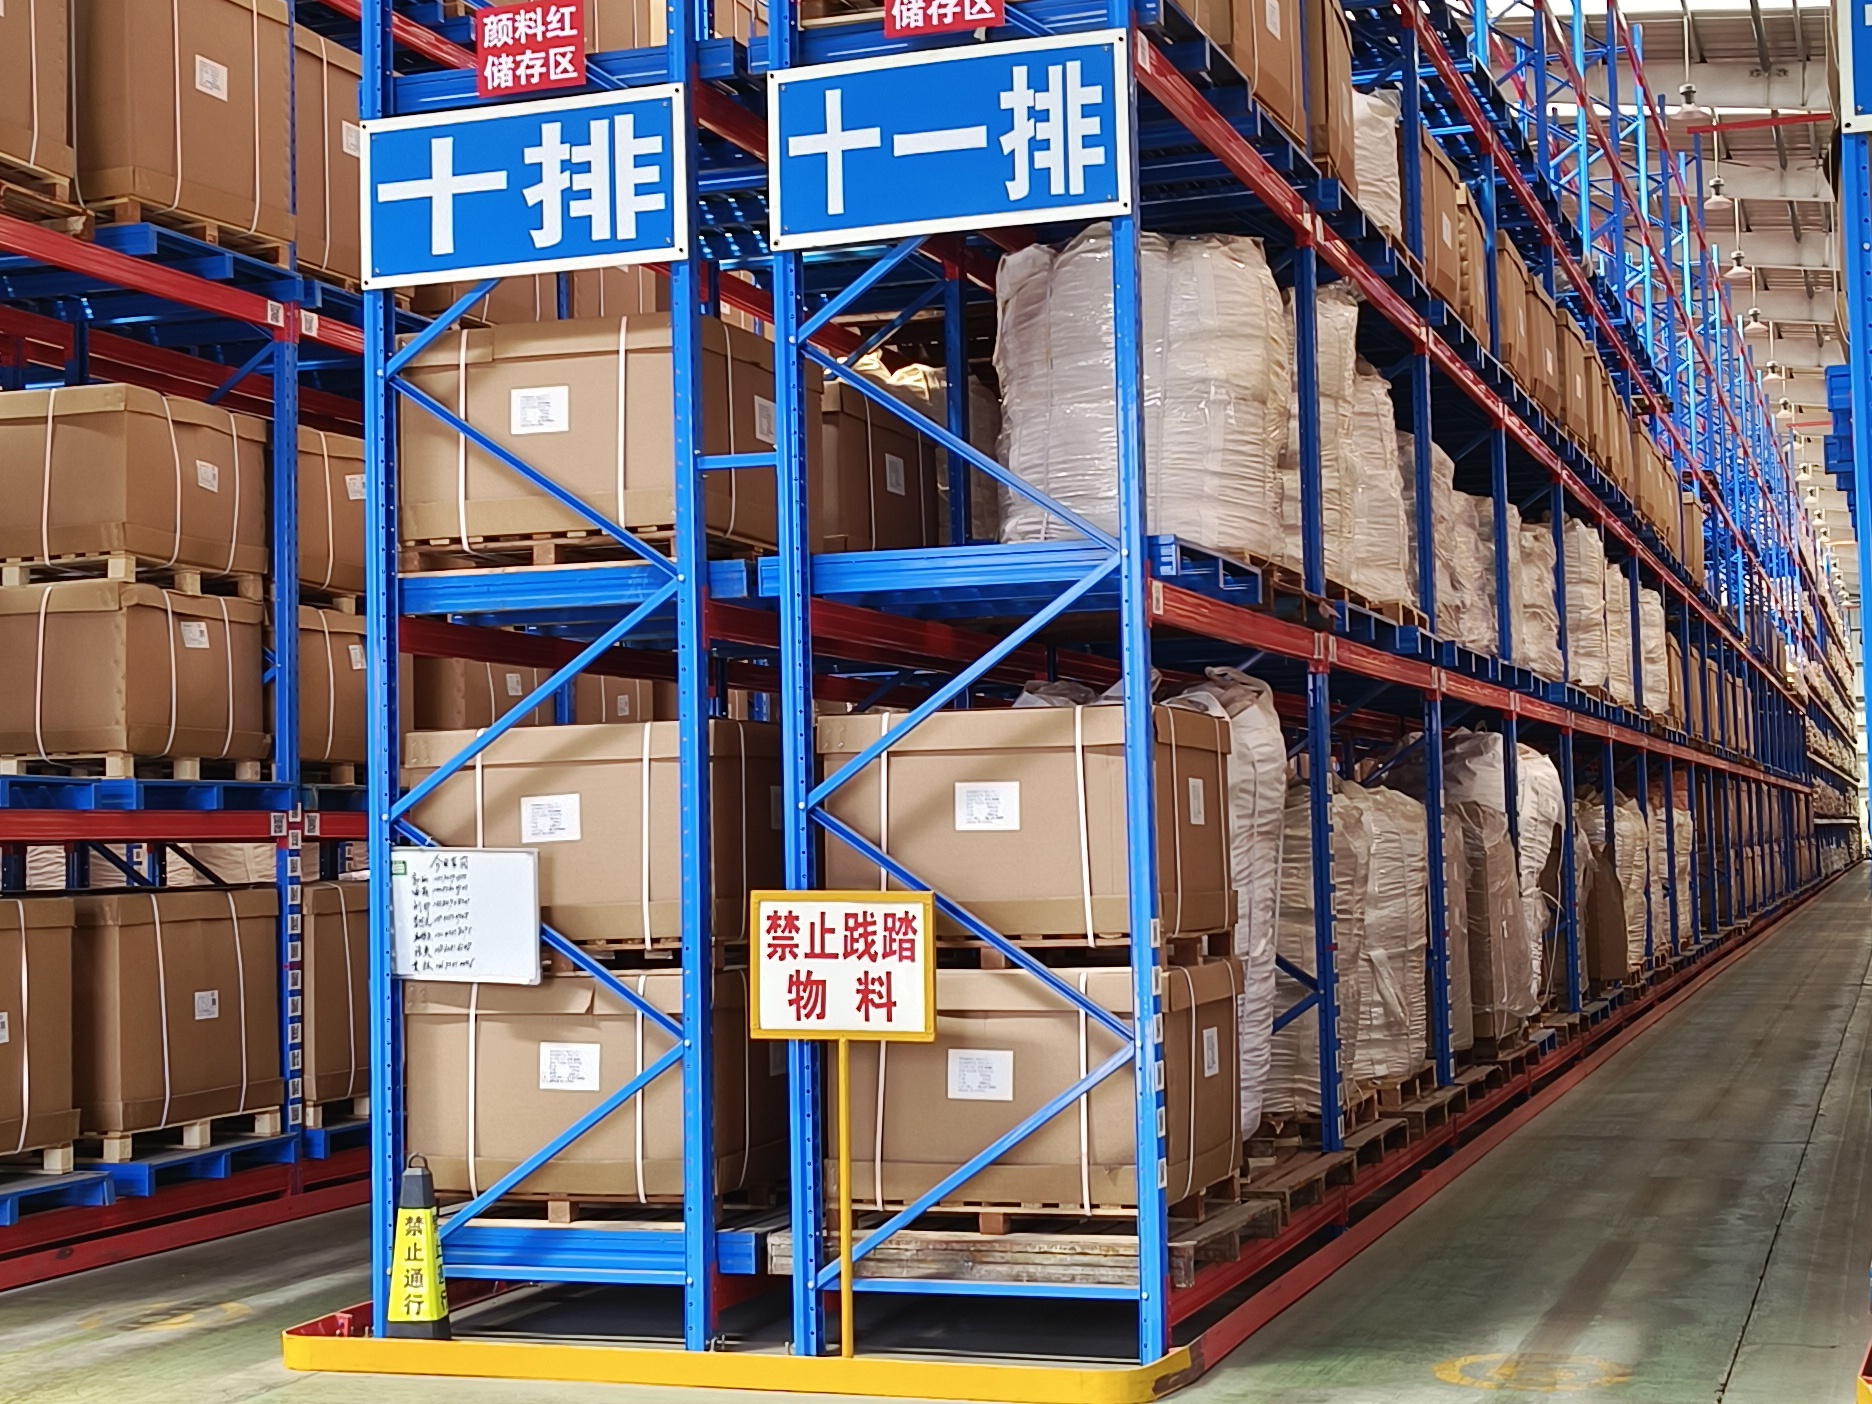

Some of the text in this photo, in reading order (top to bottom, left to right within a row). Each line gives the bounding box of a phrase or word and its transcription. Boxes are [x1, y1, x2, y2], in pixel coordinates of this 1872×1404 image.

[482, 4, 578, 49] 颜料红
[891, 0, 996, 30] 储存区
[483, 45, 579, 91] 储存区
[787, 60, 1106, 216] 十一排
[376, 113, 667, 256] 十排
[765, 909, 918, 963] 禁止践踏
[403, 1215, 425, 1316] 禁止通行
